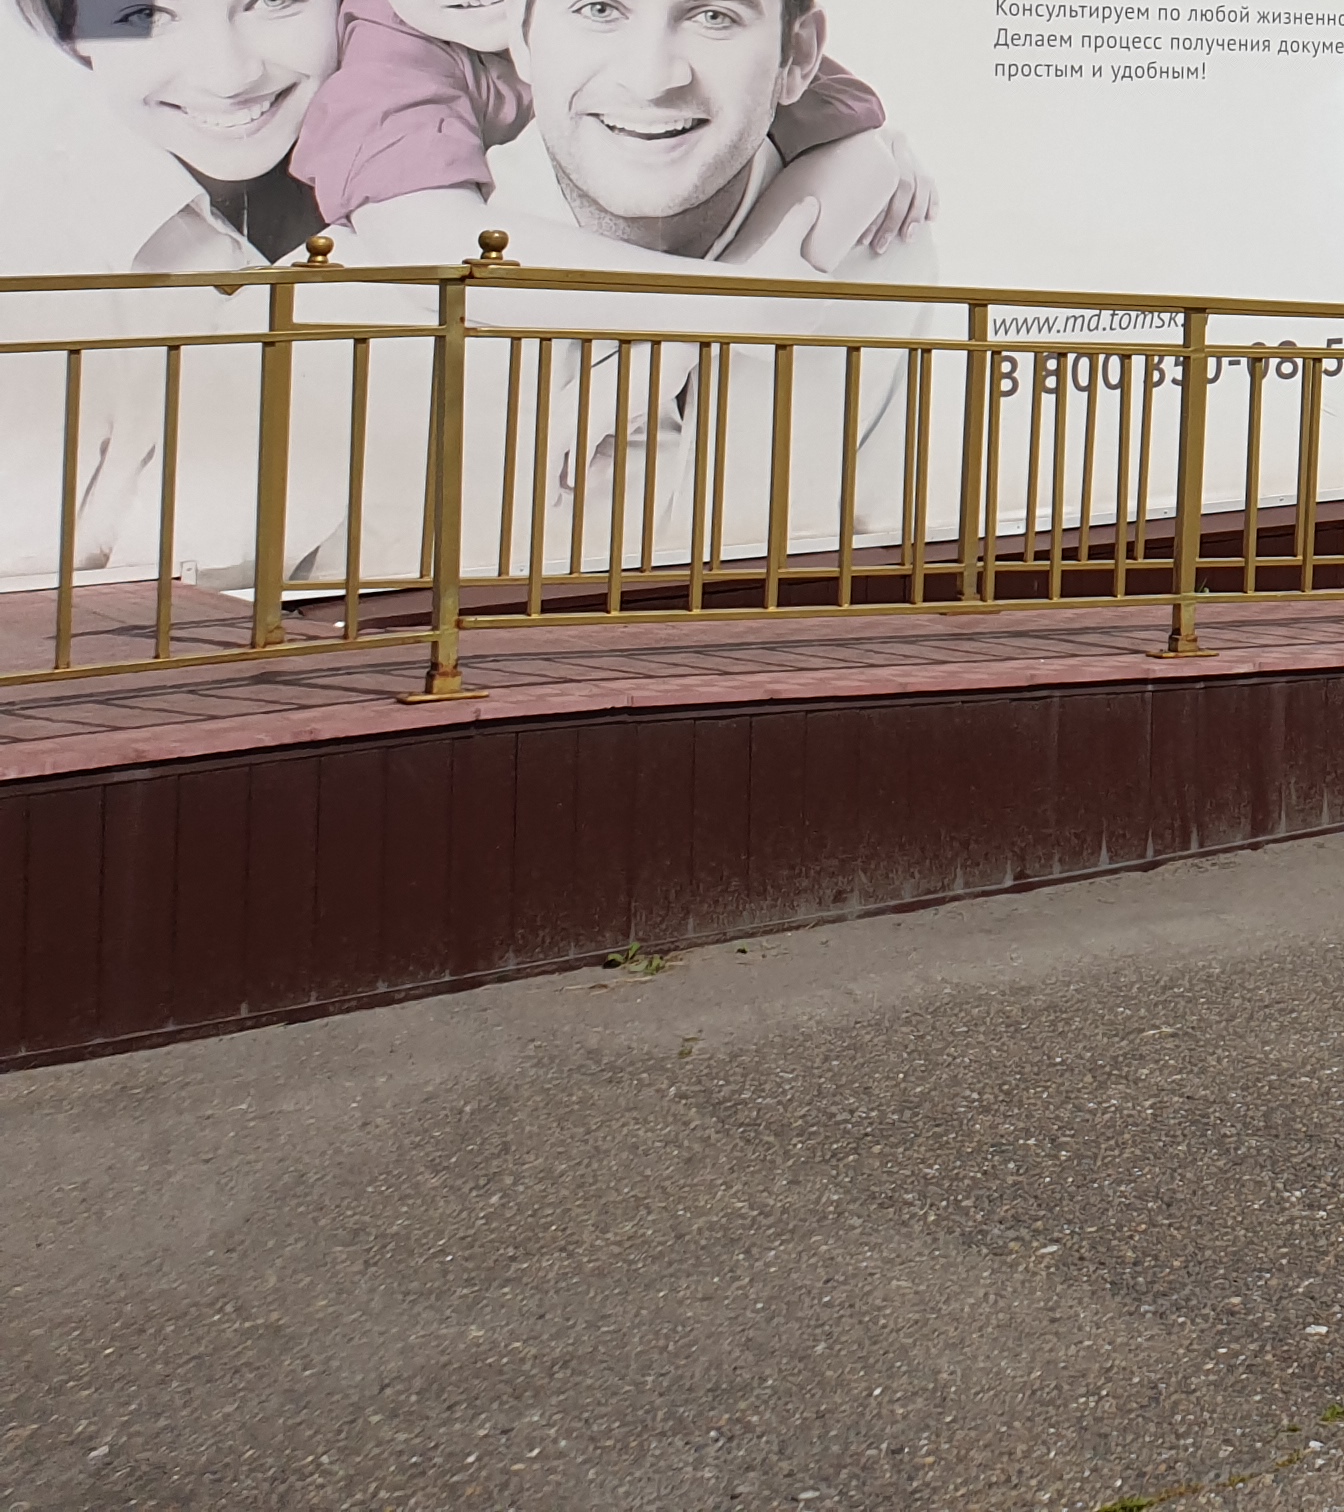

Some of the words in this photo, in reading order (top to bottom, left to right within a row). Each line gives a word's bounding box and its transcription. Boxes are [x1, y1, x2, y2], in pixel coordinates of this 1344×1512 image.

[1158, 6, 1181, 22] по
[1187, 4, 1251, 25] любой
[994, 28, 1073, 52] Делаем
[1080, 34, 1163, 55] процесс
[1169, 37, 1272, 57] получения
[994, 61, 1084, 83] простым
[1092, 64, 1104, 78] и
[1110, 62, 1208, 84] удобным!
[993, 311, 1208, 337] www.md.tomsk.
[999, 355, 1019, 397] 8
